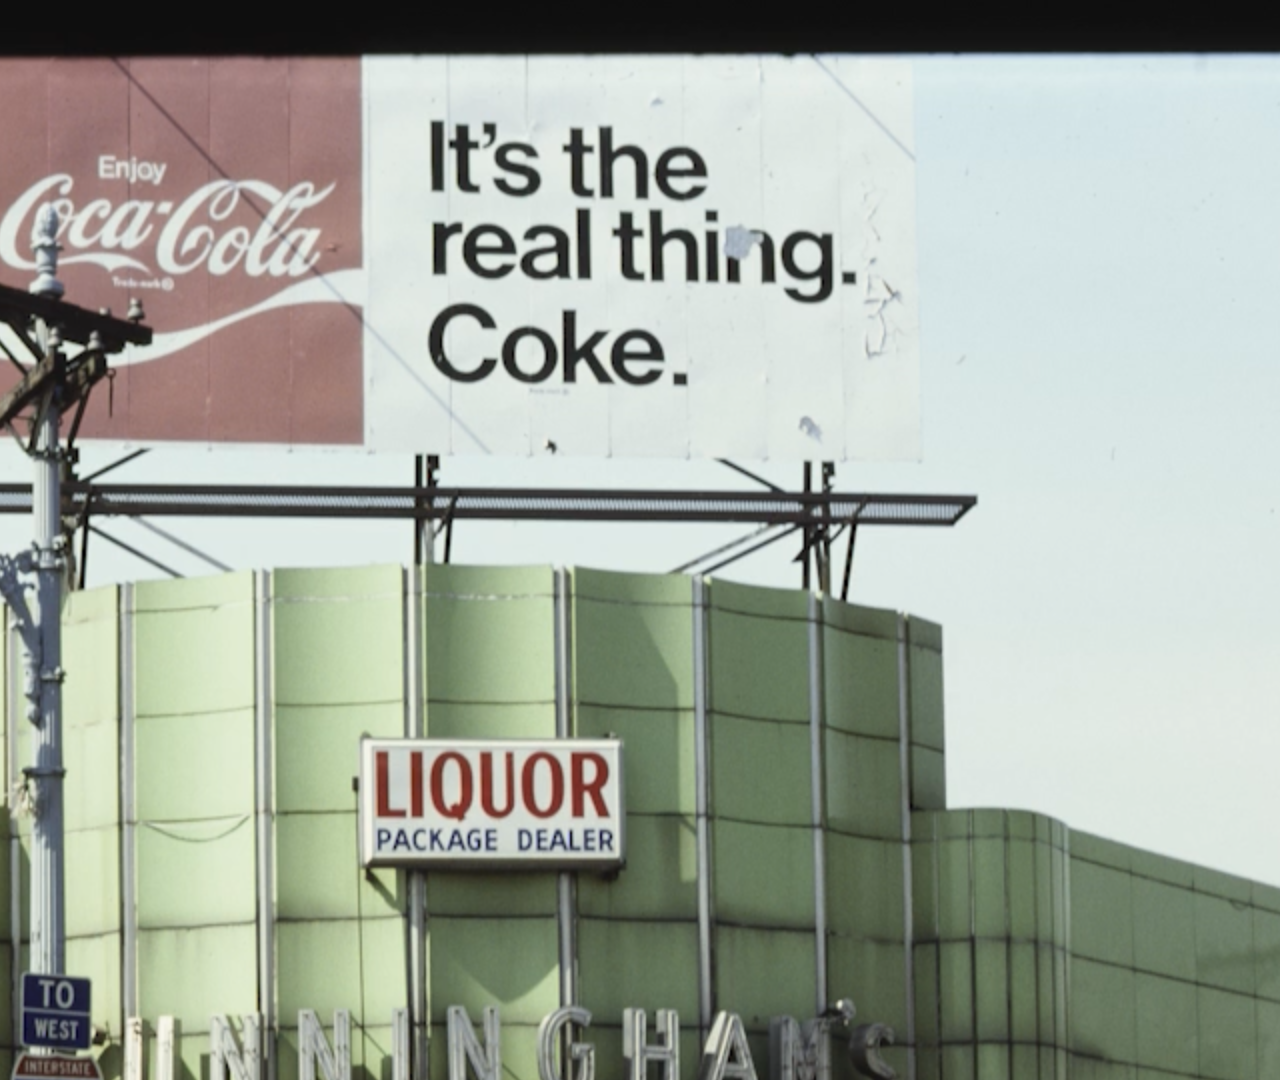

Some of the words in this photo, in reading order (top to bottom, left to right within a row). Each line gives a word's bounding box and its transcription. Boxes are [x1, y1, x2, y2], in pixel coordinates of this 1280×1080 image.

[98, 155, 166, 185] Enjoy
[429, 119, 540, 197] It's
[563, 126, 708, 201] the
[431, 210, 591, 279] real
[612, 210, 857, 303] thing.
[427, 303, 690, 386] Coke.
[374, 750, 611, 820] LIQUOR
[376, 828, 498, 853] PACKAGE
[518, 828, 614, 853] DEALER
[39, 980, 75, 1009] TO
[34, 1018, 79, 1041] WEST
[24, 1060, 92, 1076] INTERSTATE
